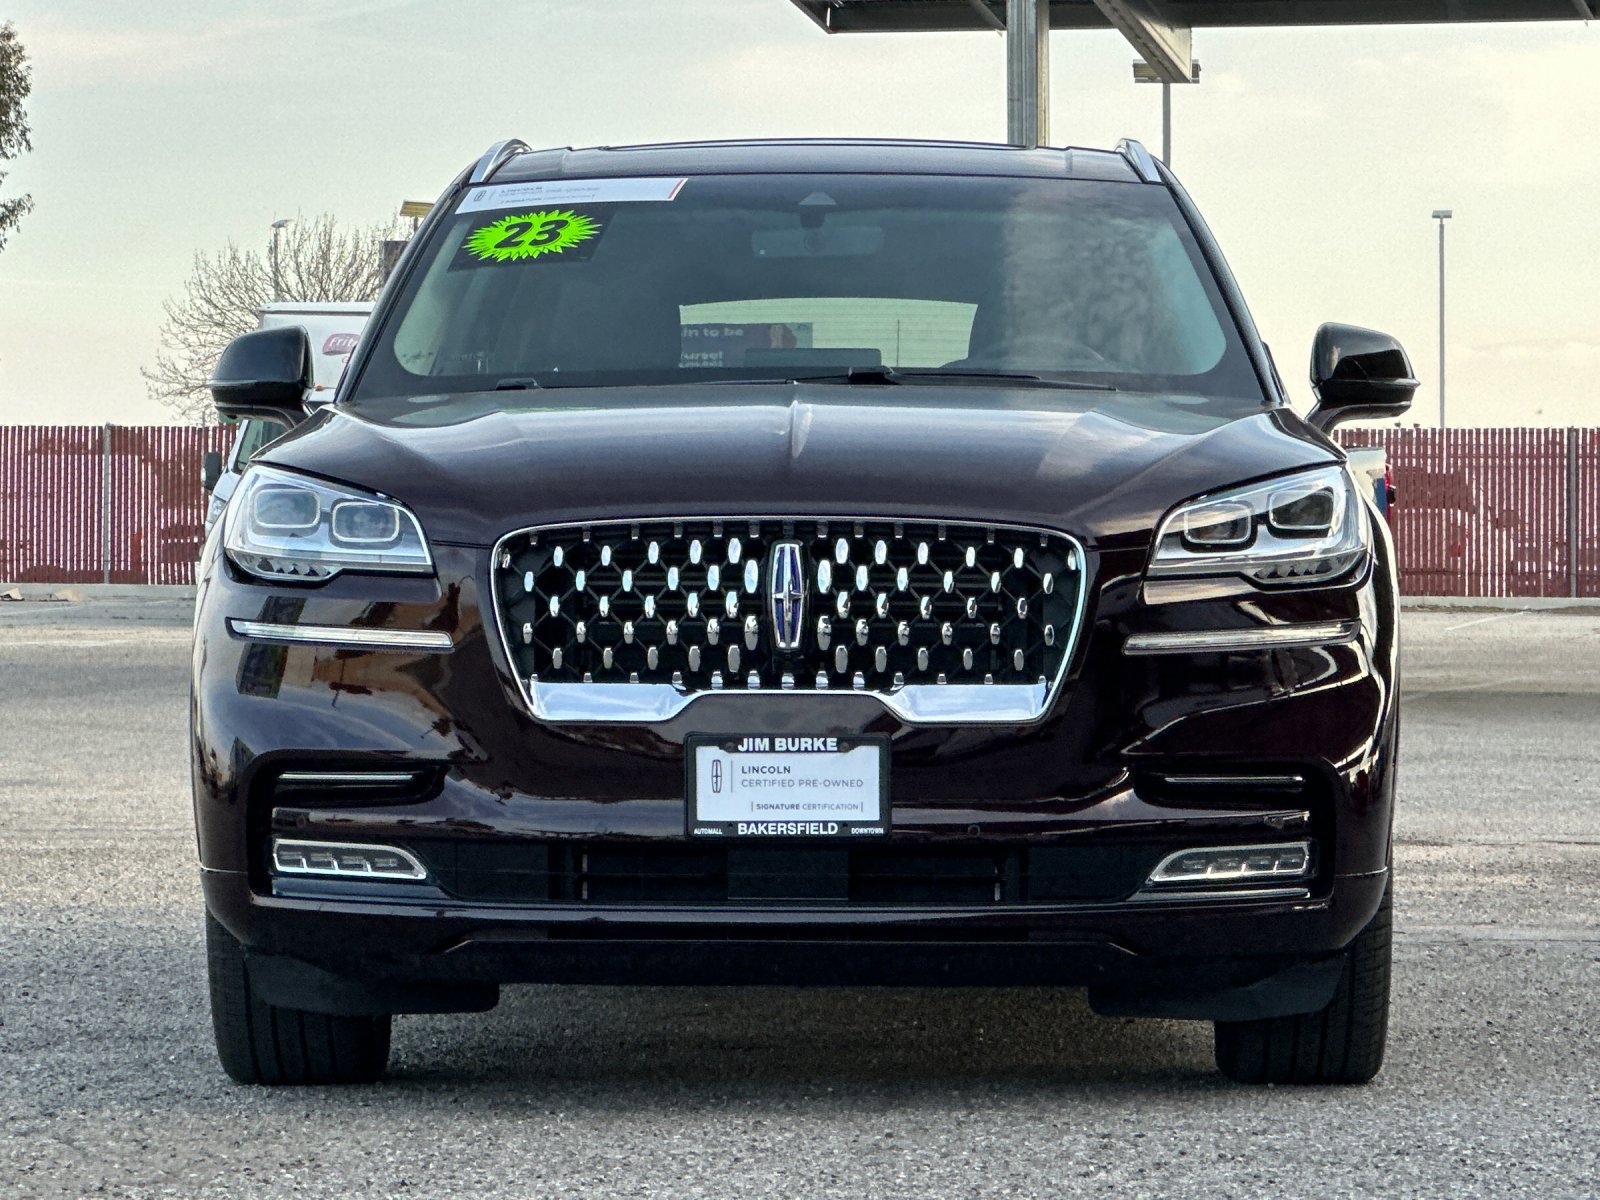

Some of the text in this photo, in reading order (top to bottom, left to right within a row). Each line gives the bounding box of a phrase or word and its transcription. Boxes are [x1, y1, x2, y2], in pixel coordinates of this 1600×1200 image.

[494, 219, 570, 249] 23
[703, 328, 720, 337] to
[724, 327, 744, 337] be
[737, 737, 838, 752] JIM BURKE
[741, 765, 791, 775] LINCOLN
[741, 779, 864, 788] CERTIFIED PRE-OWNED
[756, 803, 859, 811] SIGNATURE CERTIFICATION
[737, 822, 838, 835] BAKERSFIELD
